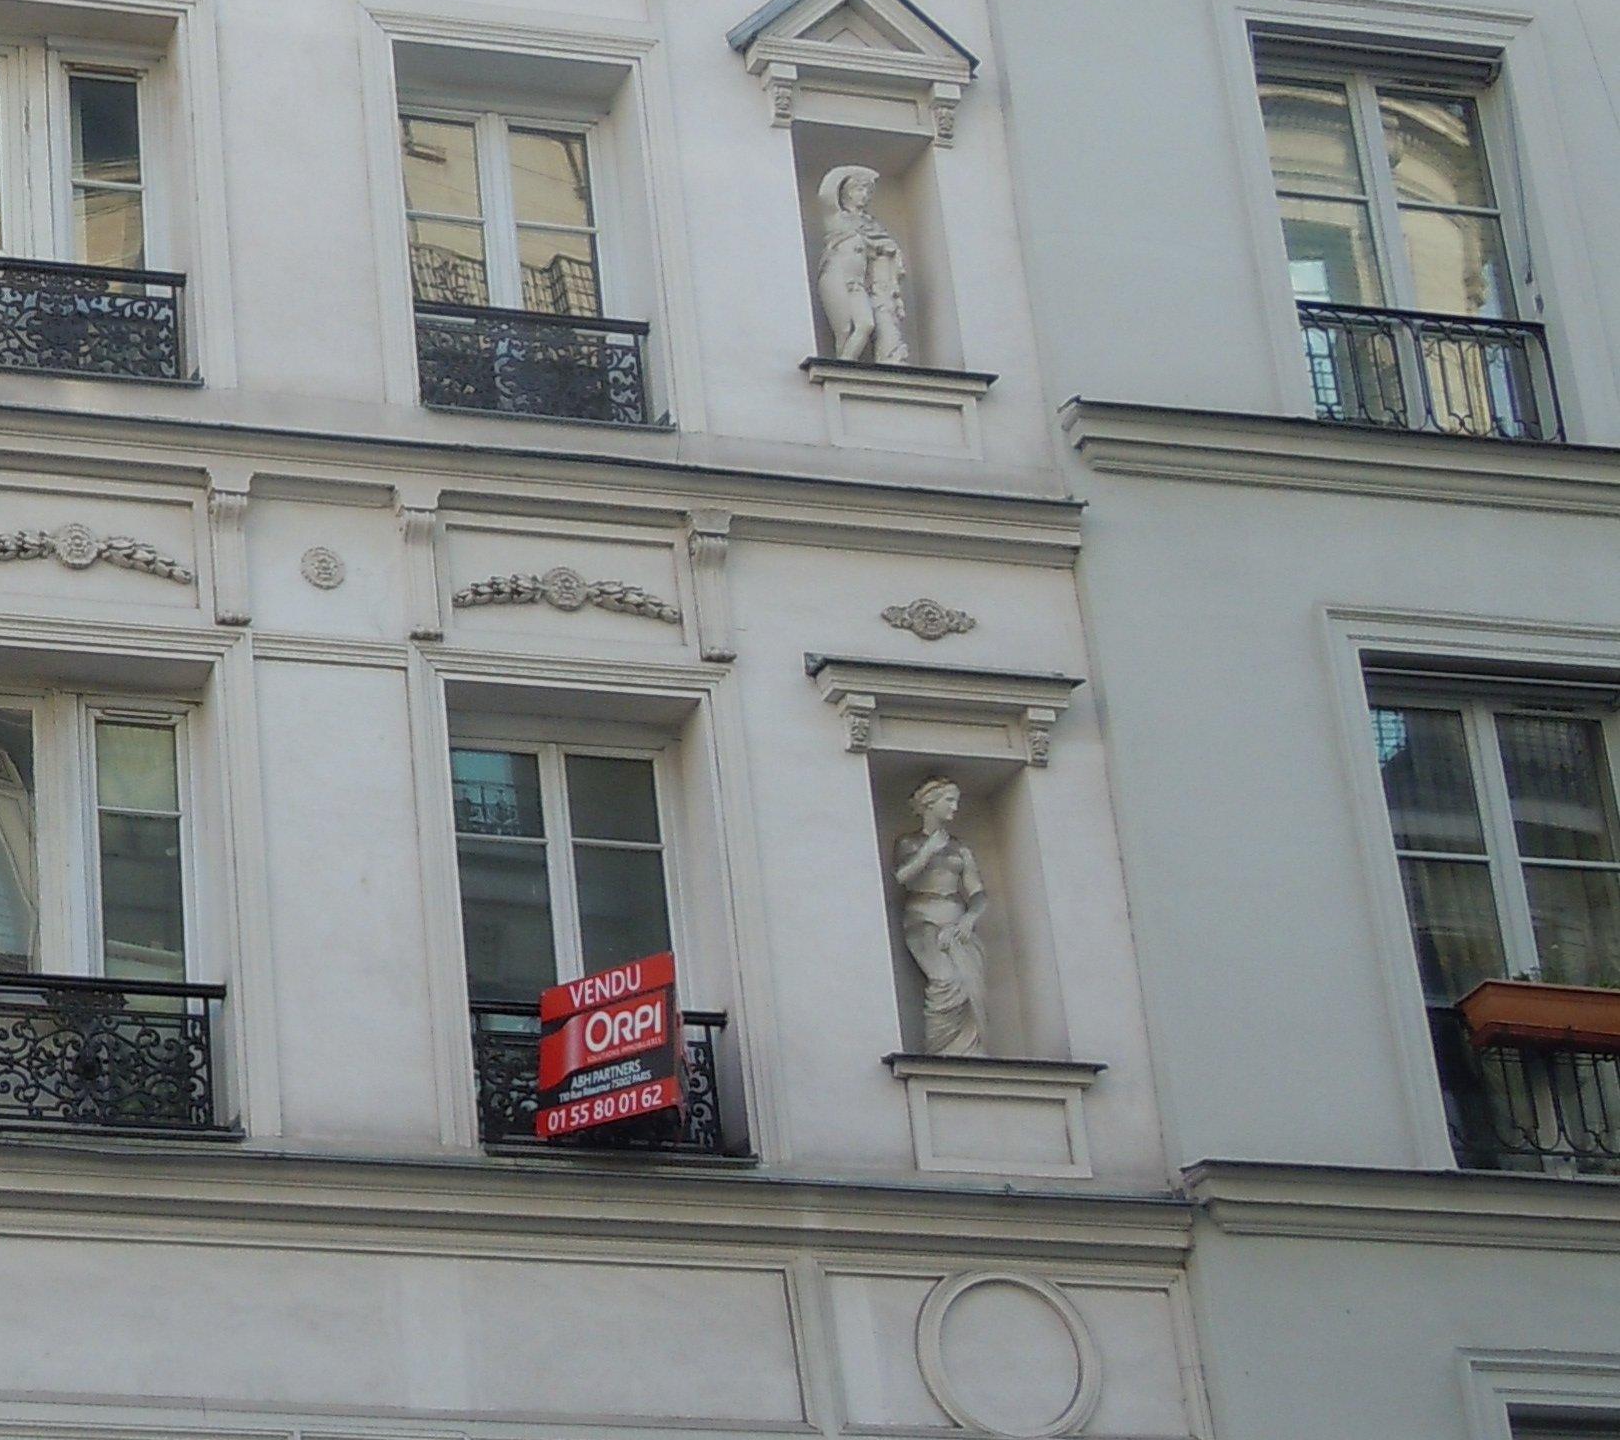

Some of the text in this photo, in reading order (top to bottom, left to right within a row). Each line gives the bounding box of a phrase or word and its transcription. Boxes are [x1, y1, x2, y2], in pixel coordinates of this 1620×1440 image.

[569, 964, 641, 1008] VENDU
[584, 1000, 662, 1053] ORPI
[571, 1058, 642, 1089] ABH PARTNERS
[547, 1084, 663, 1132] 01 55 80 01 62
